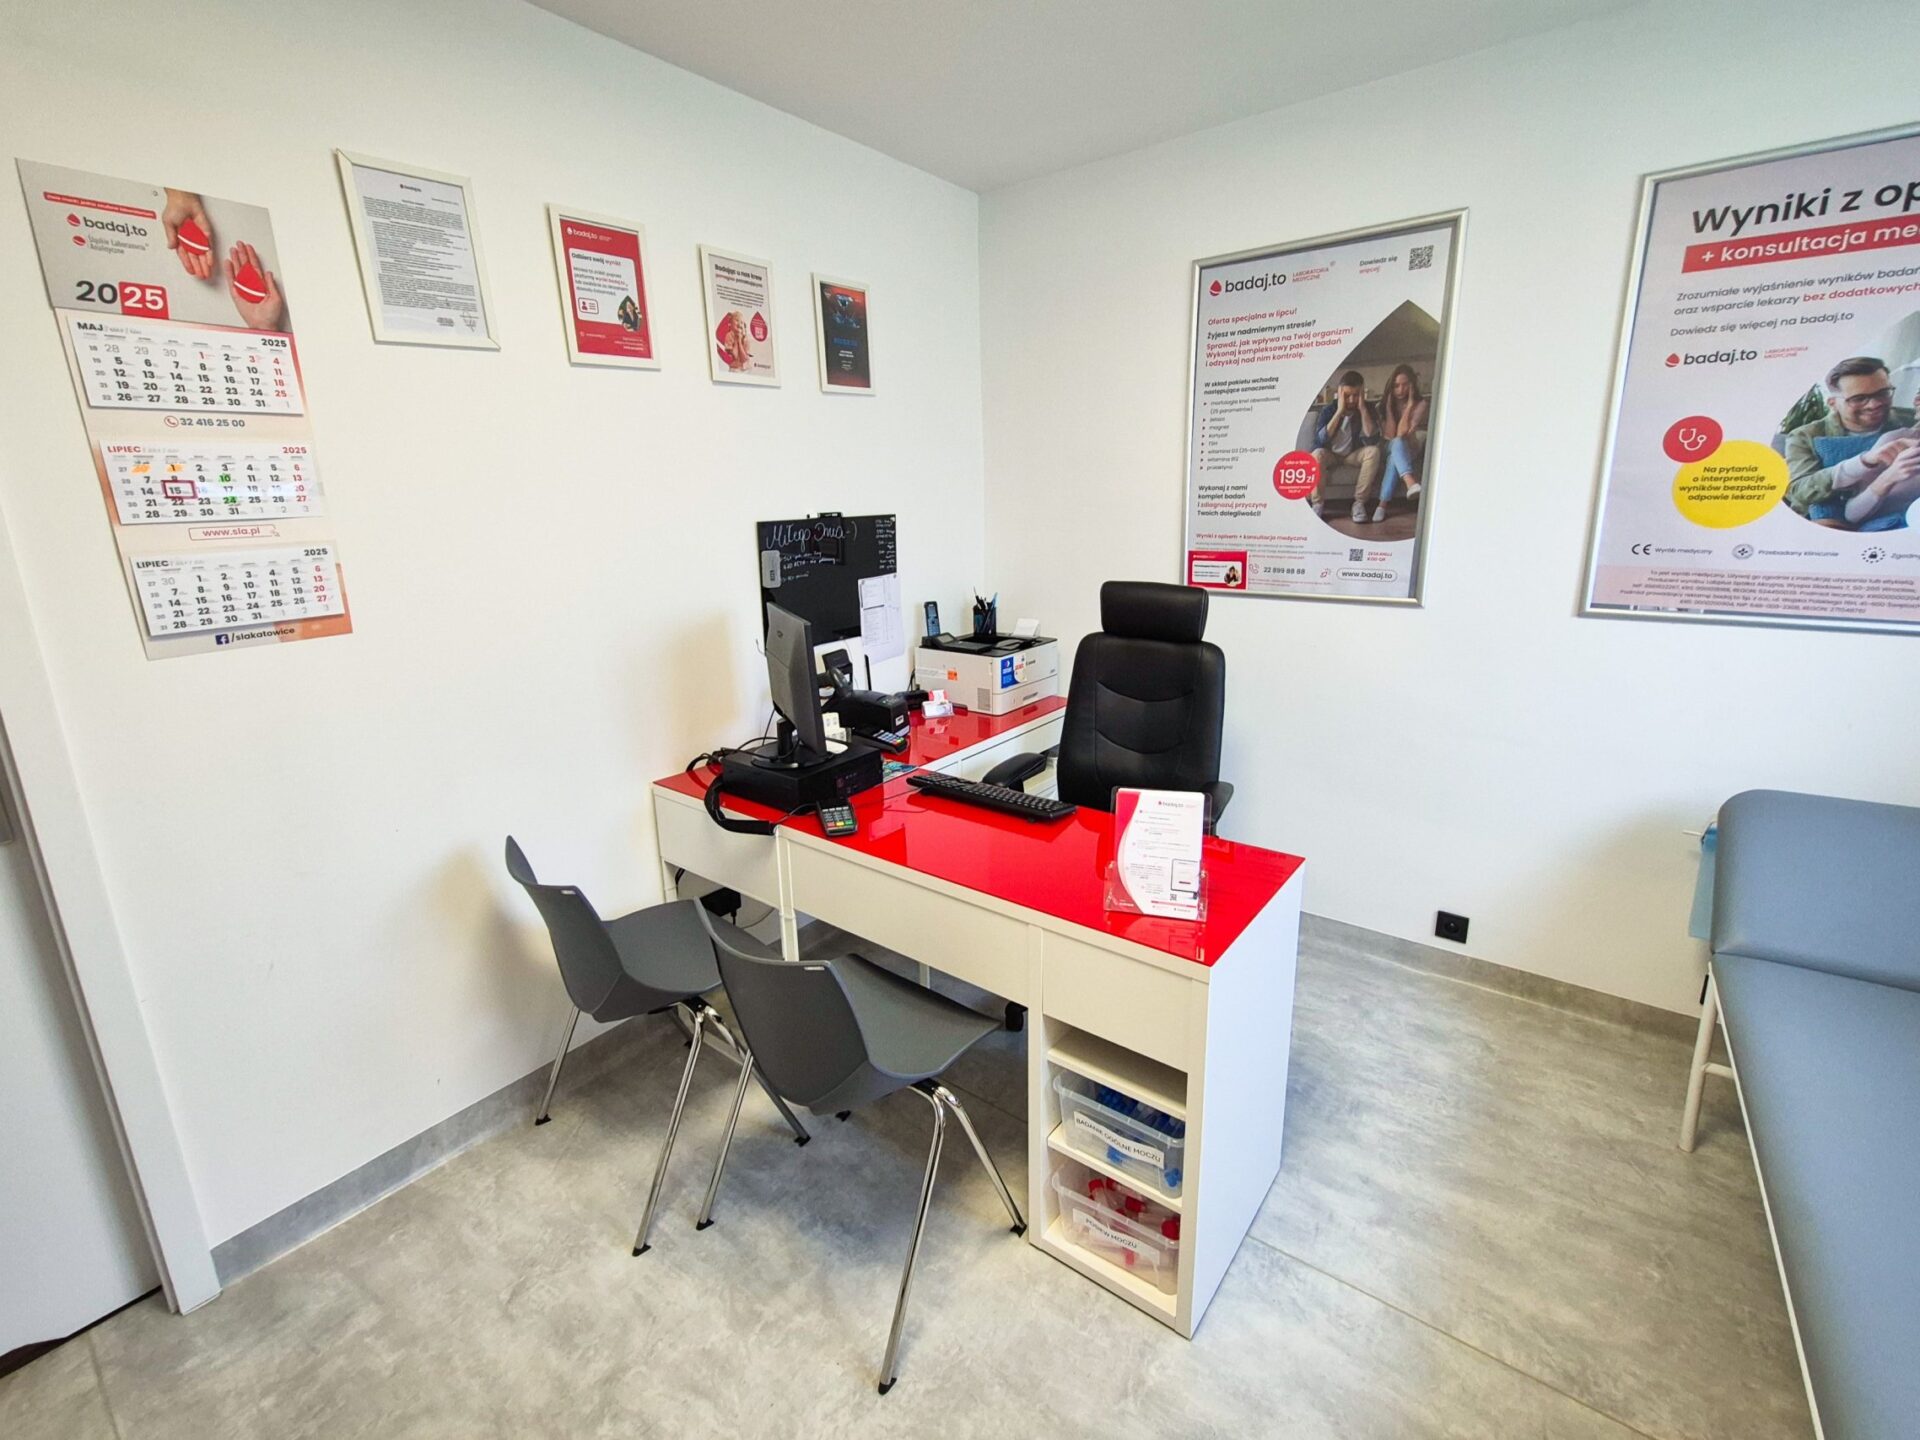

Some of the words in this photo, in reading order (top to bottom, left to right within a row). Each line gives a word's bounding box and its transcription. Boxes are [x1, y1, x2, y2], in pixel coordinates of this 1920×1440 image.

[1692, 187, 1831, 237] Wyniki
[1840, 189, 1864, 212] z
[83, 216, 147, 237] badaj.to
[1701, 251, 1715, 263] +
[1721, 228, 1866, 262] konsultacja
[1873, 224, 1920, 242] me
[1359, 258, 1386, 267] Dowiedz
[1388, 256, 1397, 264] się
[1292, 267, 1329, 277] LABORATORIA
[1225, 273, 1286, 293] badaj.to
[1677, 287, 1740, 301] Zrozumiałe
[1742, 278, 1815, 294] wyjaśnienie
[1818, 272, 1874, 287] wyników
[75, 280, 165, 311] 2025
[1674, 307, 1698, 315] oraz
[1701, 300, 1754, 313] wsparcie
[1756, 296, 1800, 307] lekarzy
[1803, 293, 1825, 302] bez
[1208, 317, 1230, 325] Oferta
[1231, 312, 1266, 324] specjalna
[1276, 308, 1297, 318] lipcu!
[1670, 324, 1717, 336] Dowiedz
[1720, 323, 1736, 332] się
[1740, 318, 1778, 330] więcej
[1780, 318, 1797, 326] na
[1800, 312, 1854, 325] badaj.to
[77, 322, 103, 331] MAJ
[261, 339, 287, 347] 2025
[1208, 331, 1228, 339] Żyjesz
[1237, 324, 1285, 335] nadmiernym
[1286, 320, 1316, 330] stresie?
[1207, 341, 1238, 350] Sprawdź,
[1239, 340, 1250, 348] jak
[1252, 337, 1280, 346] wpływa
[1294, 332, 1311, 340] Twój
[1312, 328, 1353, 340] organizm!
[1206, 351, 1237, 359] Wykonaj
[1238, 345, 1288, 356] kompleksowy
[1290, 341, 1313, 352] pakiet
[1315, 338, 1342, 347] badań
[115, 357, 123, 365] 5
[145, 359, 152, 367] 6
[173, 361, 179, 369] 7
[1209, 358, 1240, 368] odzyskaj
[1272, 352, 1305, 360] kontrolę.
[1683, 349, 1758, 366] badaj.to
[113, 368, 126, 377] 12
[142, 371, 155, 379] 13
[198, 374, 209, 382] 15
[116, 381, 129, 389] 19
[143, 382, 158, 390] 20
[175, 384, 185, 392] 21
[199, 386, 212, 394] 22
[225, 387, 238, 395] 23
[1228, 379, 1250, 388] pakietu
[117, 393, 132, 401] 26
[147, 394, 160, 402] 27
[175, 396, 188, 404] 28
[202, 397, 215, 405] 29
[180, 418, 193, 426] 32
[196, 418, 214, 426] 416
[216, 419, 229, 427] 25
[1280, 468, 1305, 484] 199
[1718, 466, 1758, 475] pytania
[1701, 475, 1766, 484] interpretację
[1199, 484, 1225, 492] Wykonaj
[1679, 484, 1721, 494] wyników
[1723, 484, 1776, 493] bezpłatnie
[1688, 493, 1729, 501] odpowie
[1220, 510, 1261, 518] dolegliwości!
[203, 527, 260, 537] www.sla.pl
[137, 560, 168, 568] LIPIEC
[304, 548, 328, 556] 2025
[1341, 571, 1392, 580] www.badaj.to
[1076, 1118, 1103, 1136] BADANIE
[1133, 1148, 1161, 1162] MOCZU
[1110, 1234, 1137, 1248] MOCZU
